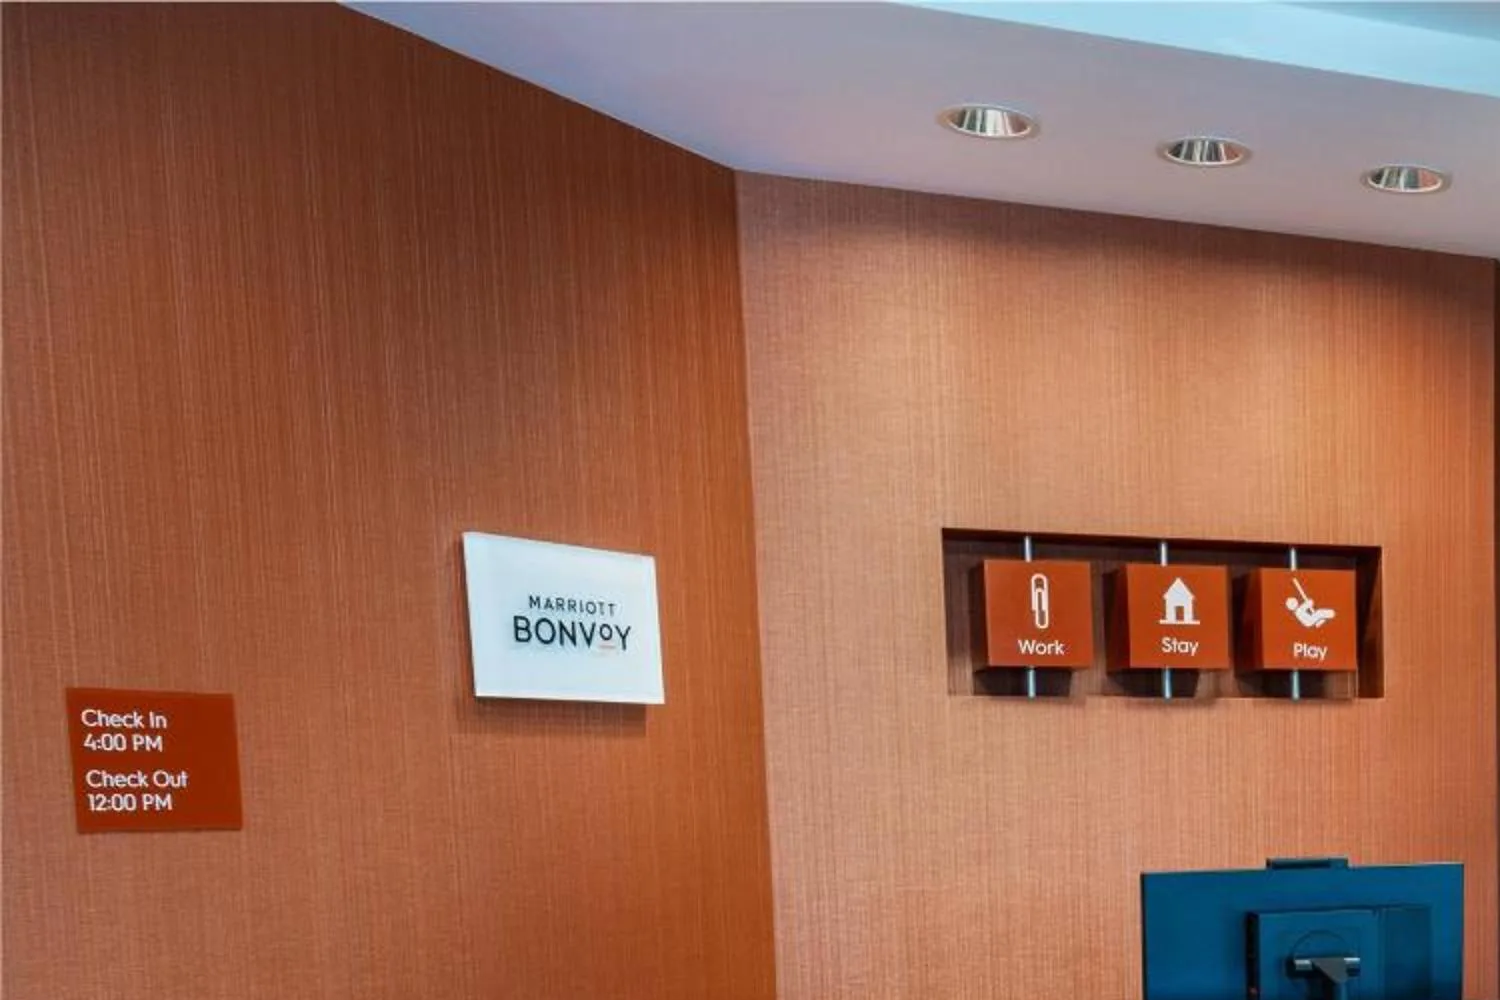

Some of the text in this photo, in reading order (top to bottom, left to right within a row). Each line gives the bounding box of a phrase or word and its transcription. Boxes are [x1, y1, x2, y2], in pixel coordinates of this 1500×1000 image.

[528, 595, 617, 616] MARRIOTT
[513, 615, 631, 651] BONVOY
[1018, 638, 1065, 656] Work
[1161, 636, 1199, 657] Stay
[1293, 642, 1328, 660] Play
[81, 708, 168, 729] Check In
[83, 733, 163, 752] 4:00 PM
[86, 769, 188, 788] Check Out
[87, 793, 173, 811] 12:00 PM
